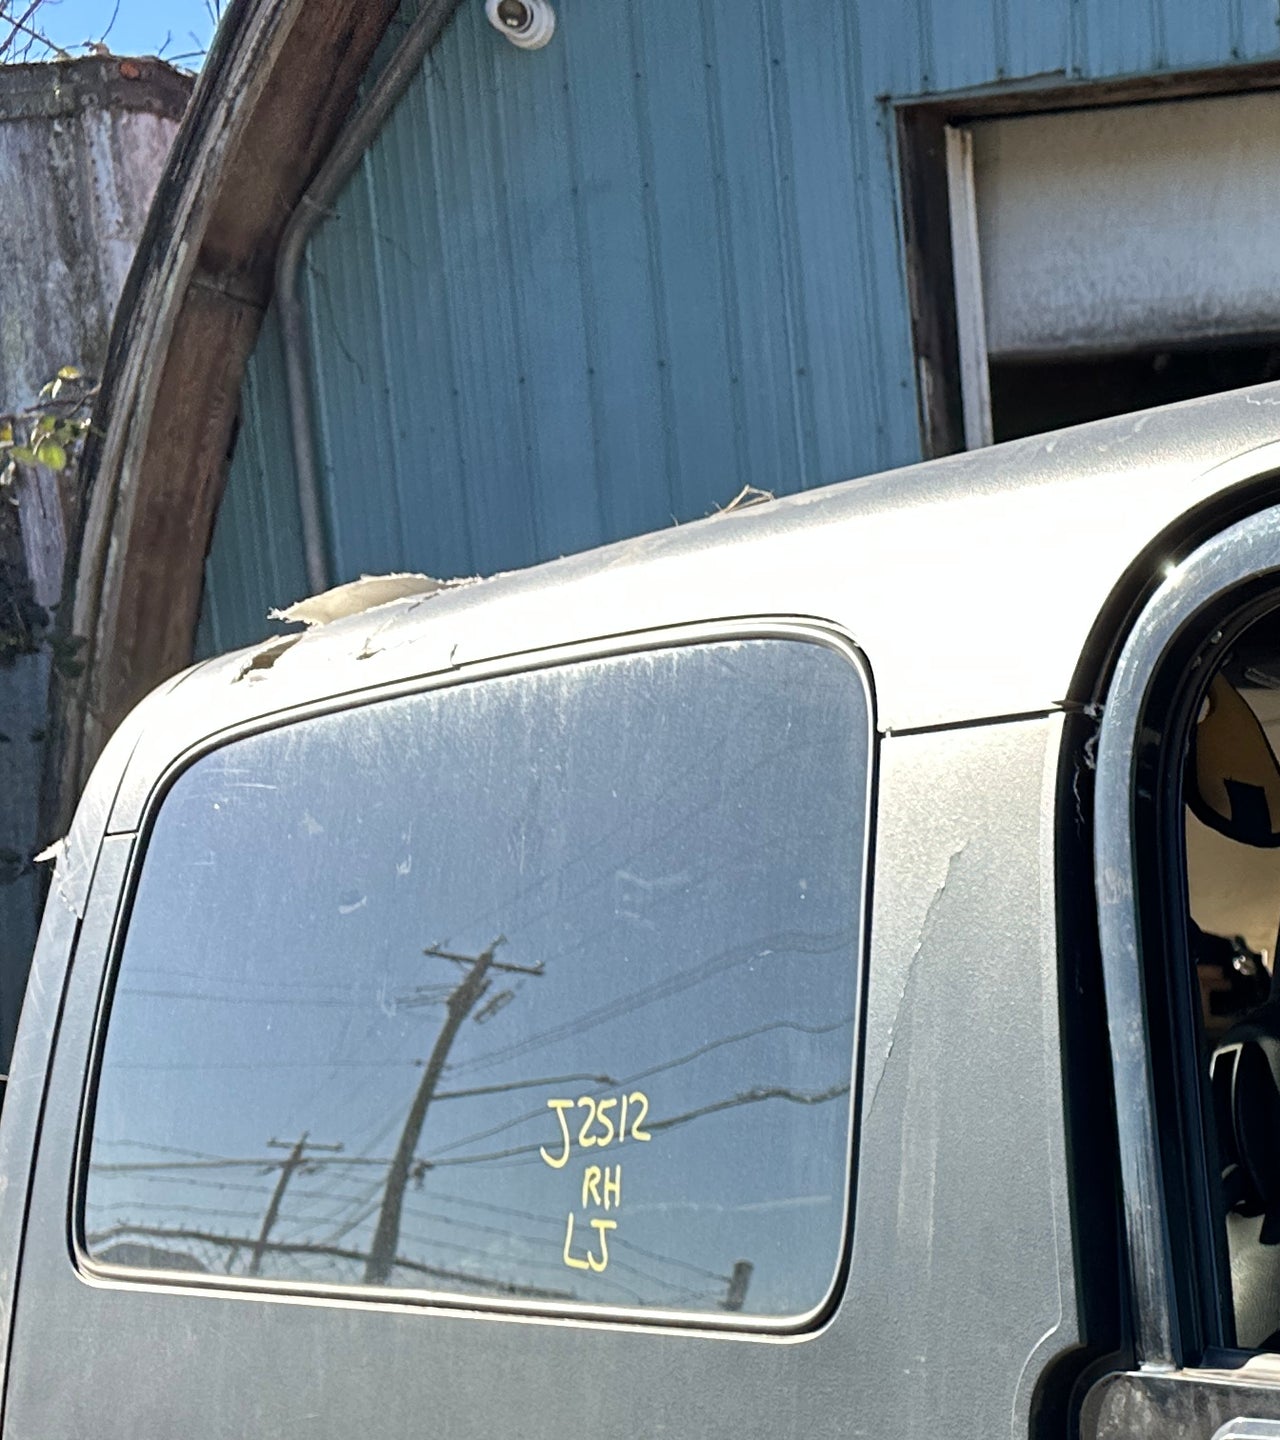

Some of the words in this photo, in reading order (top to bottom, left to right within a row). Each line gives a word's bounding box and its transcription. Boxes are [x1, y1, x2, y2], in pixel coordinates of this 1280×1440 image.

[540, 1091, 652, 1168] J2512
[582, 1164, 621, 1211] RH
[563, 1212, 617, 1272] LJ
